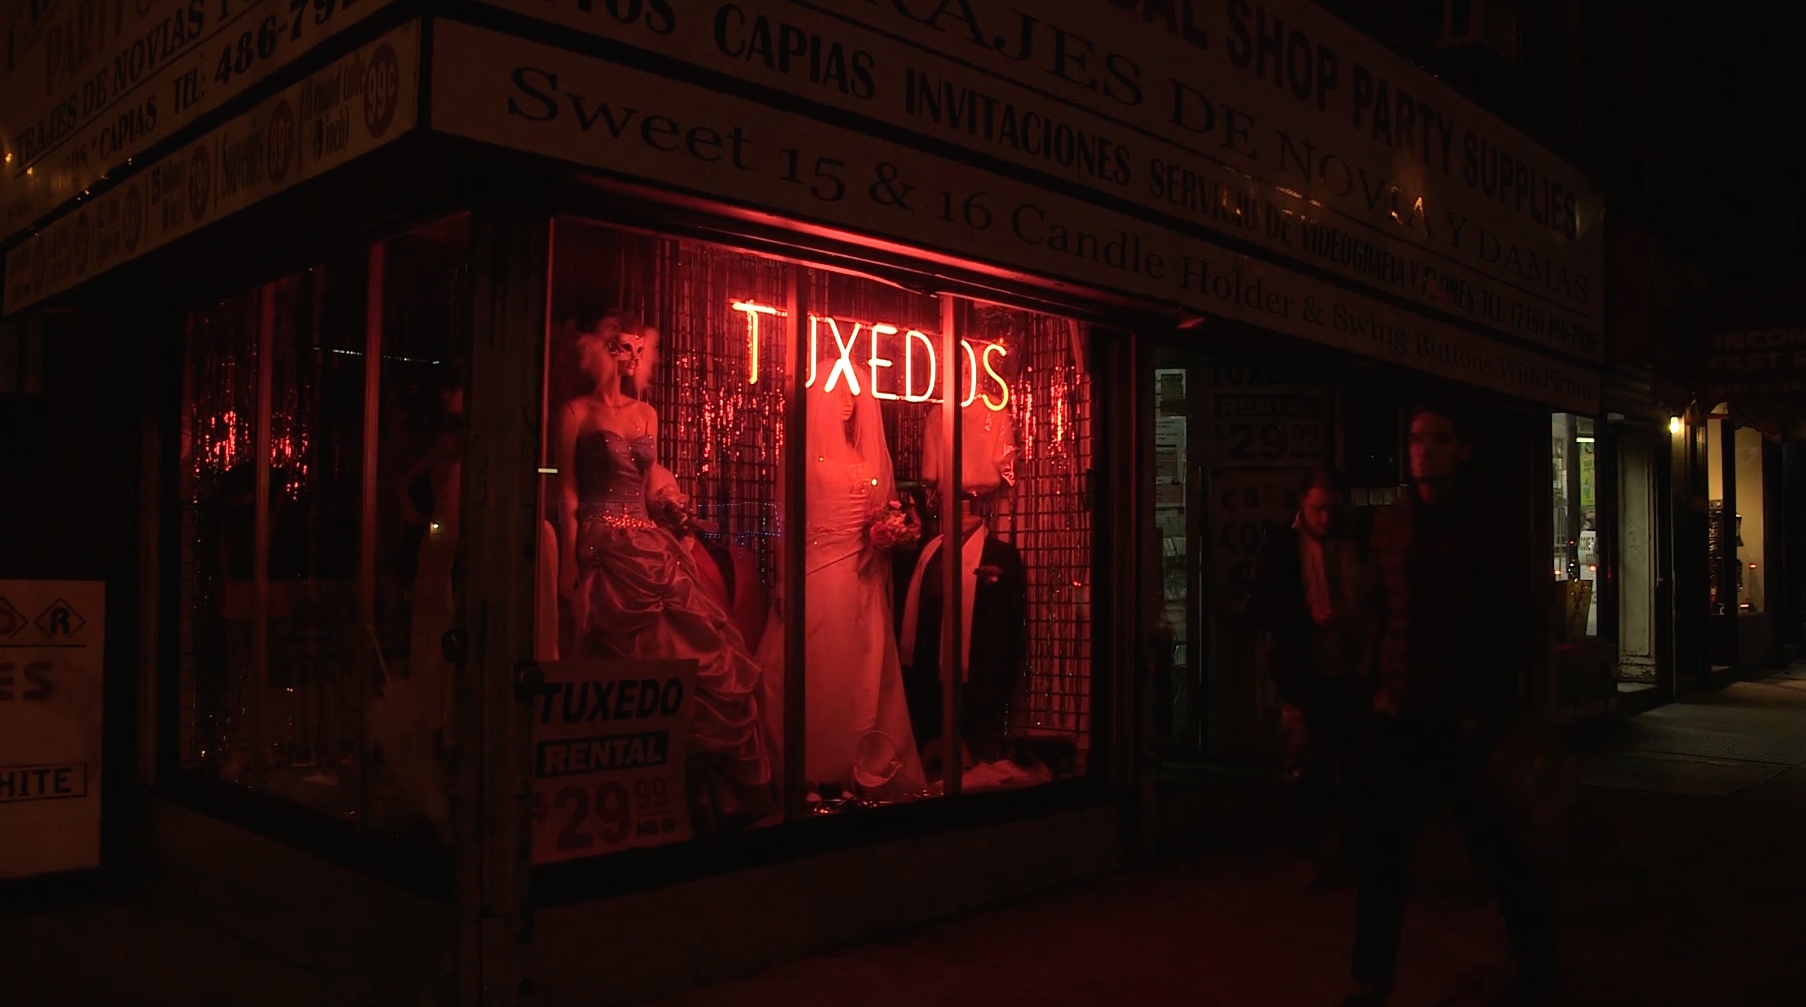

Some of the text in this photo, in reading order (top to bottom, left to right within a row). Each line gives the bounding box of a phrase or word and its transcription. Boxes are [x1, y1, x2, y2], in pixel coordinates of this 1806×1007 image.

[82, 67, 108, 119] DE
[113, 0, 205, 96] NOVIAS
[99, 94, 158, 160] CAPIAS
[214, 0, 352, 84] 486-79
[1225, 0, 1339, 112] SHOP
[1352, 62, 1455, 176] PARTY
[1462, 129, 1577, 242] SUPPLIES
[507, 65, 754, 172] Sweet
[779, 147, 846, 202] 15
[868, 161, 918, 213] &
[937, 190, 993, 231] 16
[1010, 203, 1167, 280] Candle
[1180, 253, 1297, 320] Holder
[1302, 294, 1327, 327] &
[1332, 302, 1407, 357] Swing
[1415, 329, 1492, 374] Buttons
[1499, 353, 1541, 390] With
[713, 3, 876, 101] CAPIAS
[904, 66, 1131, 187] INVITACIONES
[1265, 202, 1294, 246] DE
[1483, 288, 1504, 324] TEL
[866, 0, 1144, 106] AJES
[1168, 77, 1259, 161] DE
[1446, 210, 1469, 249] Y
[1478, 226, 1590, 304] DAMAS
[1708, 351, 1783, 371] FAST
[538, 677, 684, 725] TUXEDO
[543, 733, 663, 774] RENTAL
